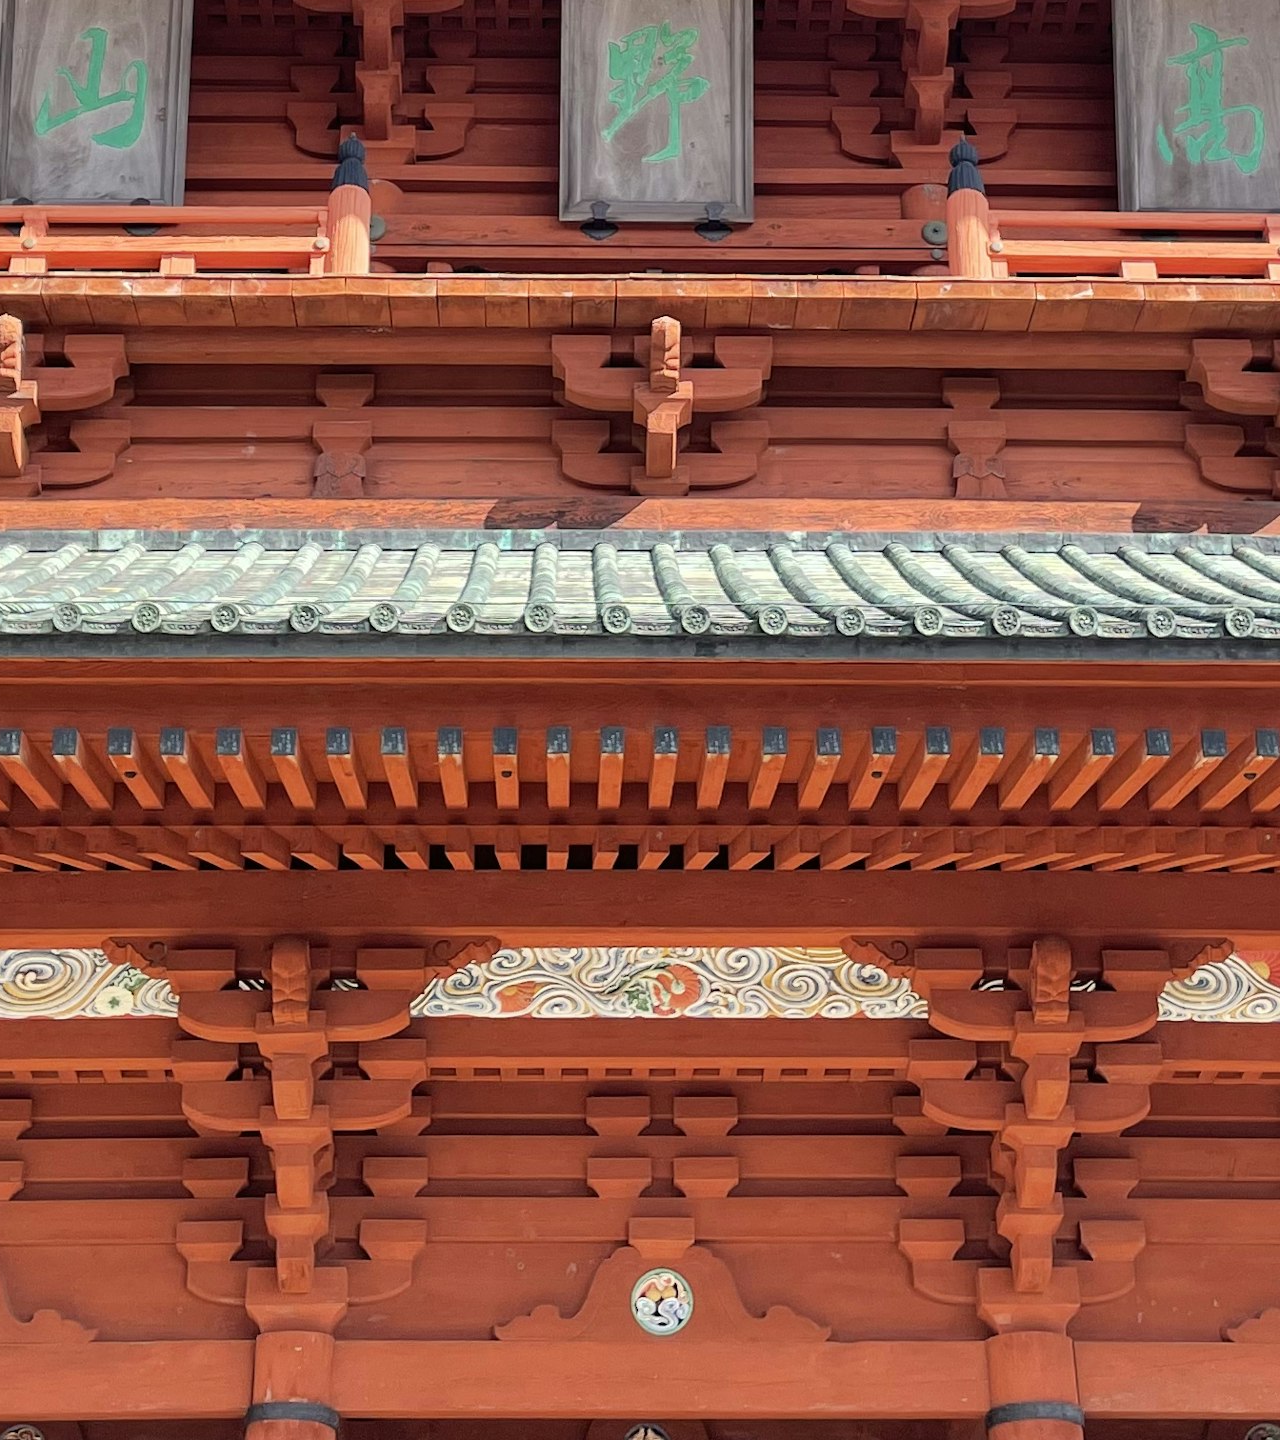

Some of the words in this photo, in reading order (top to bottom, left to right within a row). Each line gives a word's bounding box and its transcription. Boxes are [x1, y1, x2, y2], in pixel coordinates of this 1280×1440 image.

[34, 26, 149, 150] 山
[601, 20, 710, 163] 野
[1156, 22, 1265, 174] 高
